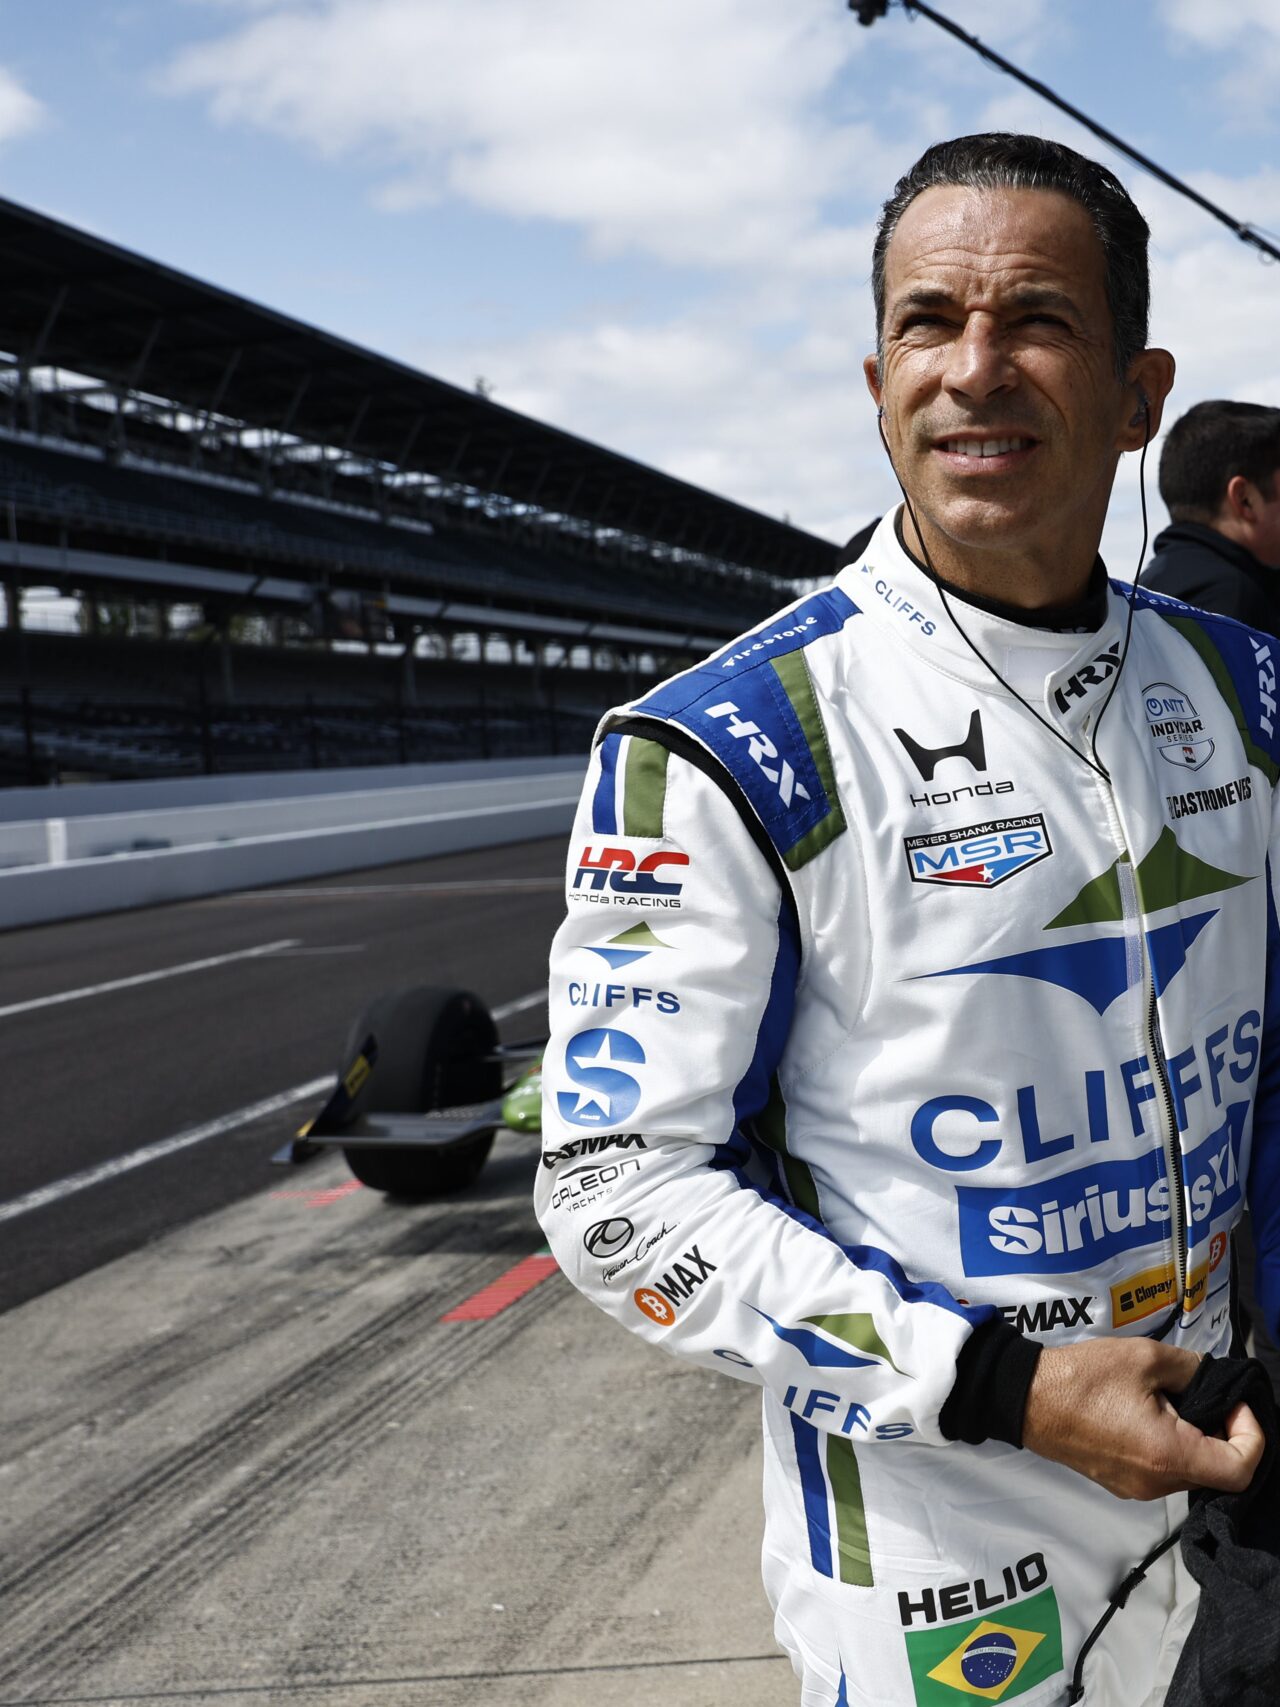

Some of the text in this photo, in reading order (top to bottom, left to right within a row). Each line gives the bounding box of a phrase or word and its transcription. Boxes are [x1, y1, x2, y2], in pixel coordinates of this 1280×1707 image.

[875, 580, 937, 637] CLIFFS
[722, 615, 818, 668] Firestone
[1053, 641, 1120, 714] HRX
[1249, 636, 1277, 740] HRX
[1163, 699, 1186, 713] NTT
[1150, 719, 1204, 737] INDYCAR
[1167, 735, 1194, 743] SERIES
[704, 701, 812, 809] HRX
[910, 780, 1015, 808] Honda
[1173, 776, 1252, 819] CASTRONEVES
[907, 816, 1041, 849] MEYER SHANK RACING
[913, 830, 1044, 874] MSR
[613, 894, 682, 909] RACING
[568, 982, 681, 1014] CLIFFS
[552, 1158, 640, 1210] GALEON
[567, 1188, 613, 1213] YACHTS
[654, 1244, 718, 1307] MAX
[1135, 1278, 1173, 1303] Clopay
[1000, 1296, 1094, 1334] EMAX
[898, 1552, 1048, 1626] HELIO
